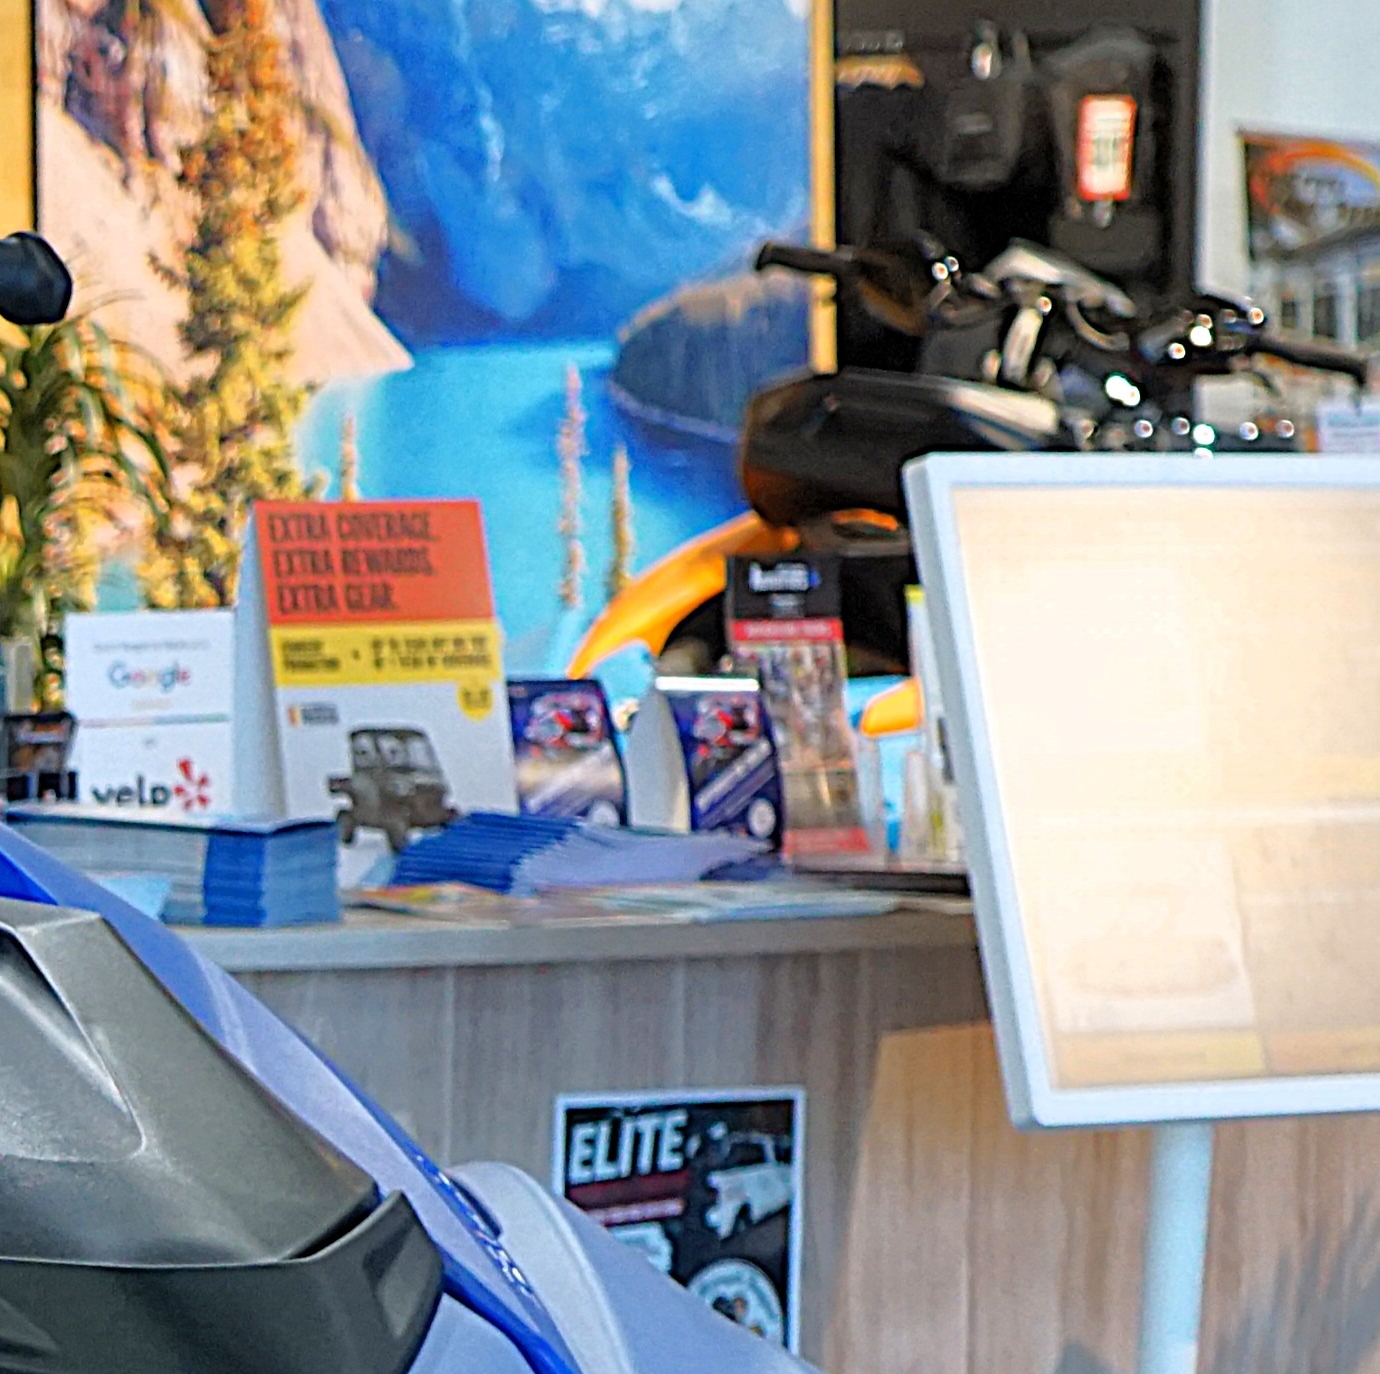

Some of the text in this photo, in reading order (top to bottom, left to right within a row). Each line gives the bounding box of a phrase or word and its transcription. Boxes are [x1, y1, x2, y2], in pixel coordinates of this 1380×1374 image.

[267, 511, 330, 542] EXTRA
[273, 547, 335, 578] EXTRA
[277, 583, 339, 614] EXTRA
[108, 659, 192, 693] Google
[569, 1110, 689, 1184] ELITE
